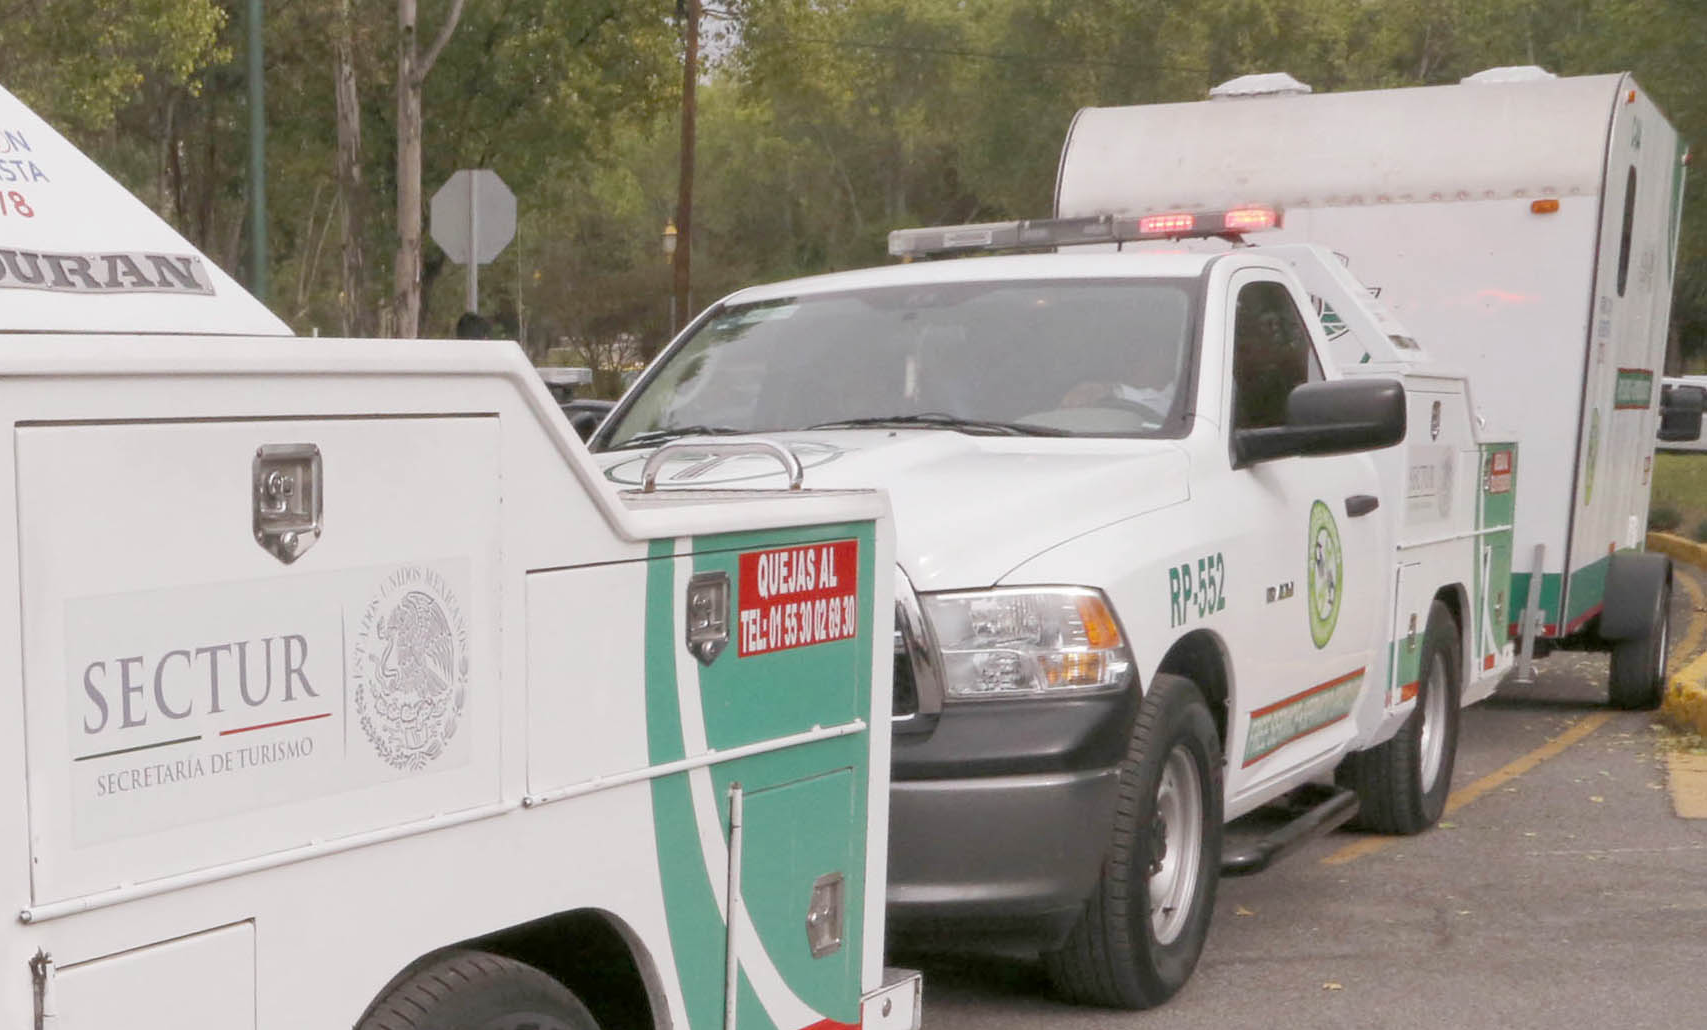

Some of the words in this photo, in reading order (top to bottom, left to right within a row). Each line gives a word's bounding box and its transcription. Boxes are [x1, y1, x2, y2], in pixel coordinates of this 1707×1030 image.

[758, 549, 816, 599] QUEJAS
[819, 546, 838, 590] AL
[1169, 552, 1226, 629] RP-552
[741, 608, 768, 653] TEL:
[769, 605, 782, 649] 01
[83, 633, 320, 735] SECTUR
[211, 753, 233, 774] DE
[238, 736, 313, 768] TURISMO
